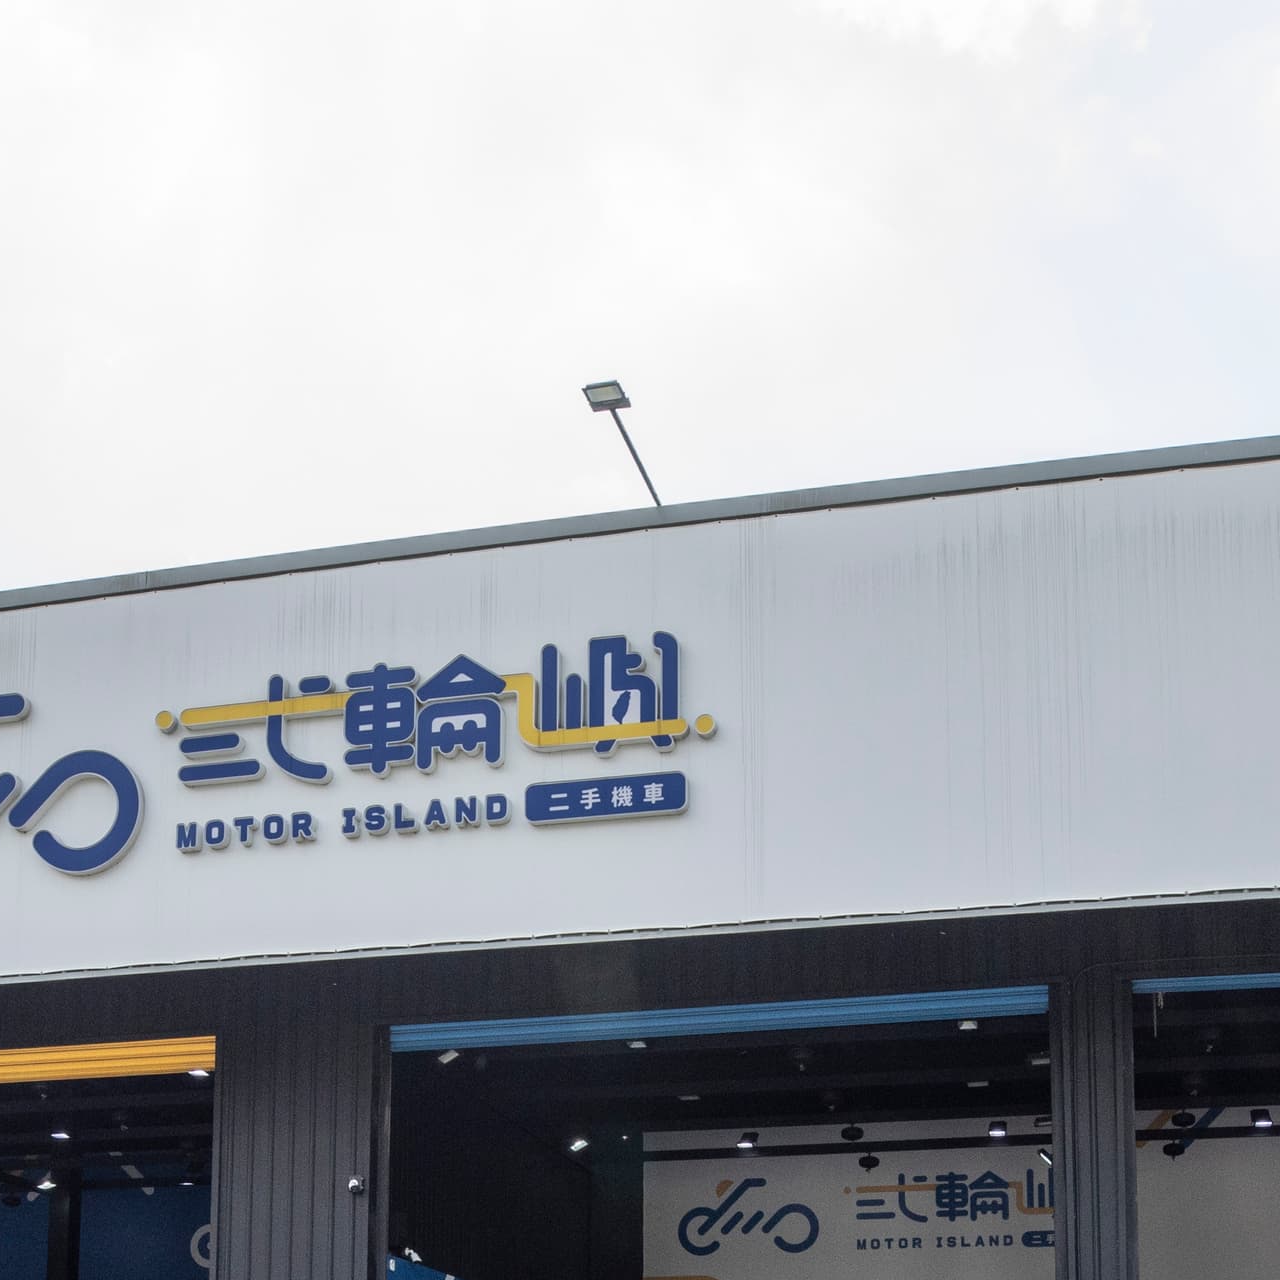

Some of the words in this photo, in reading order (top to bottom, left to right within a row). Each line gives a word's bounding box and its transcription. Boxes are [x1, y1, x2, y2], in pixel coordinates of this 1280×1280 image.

[547, 781, 666, 815] 二手機車
[175, 811, 314, 854] MOTOR
[341, 792, 510, 839] ISLAND
[856, 1236, 923, 1250] MOTOR
[935, 1234, 1013, 1249] ISLAND
